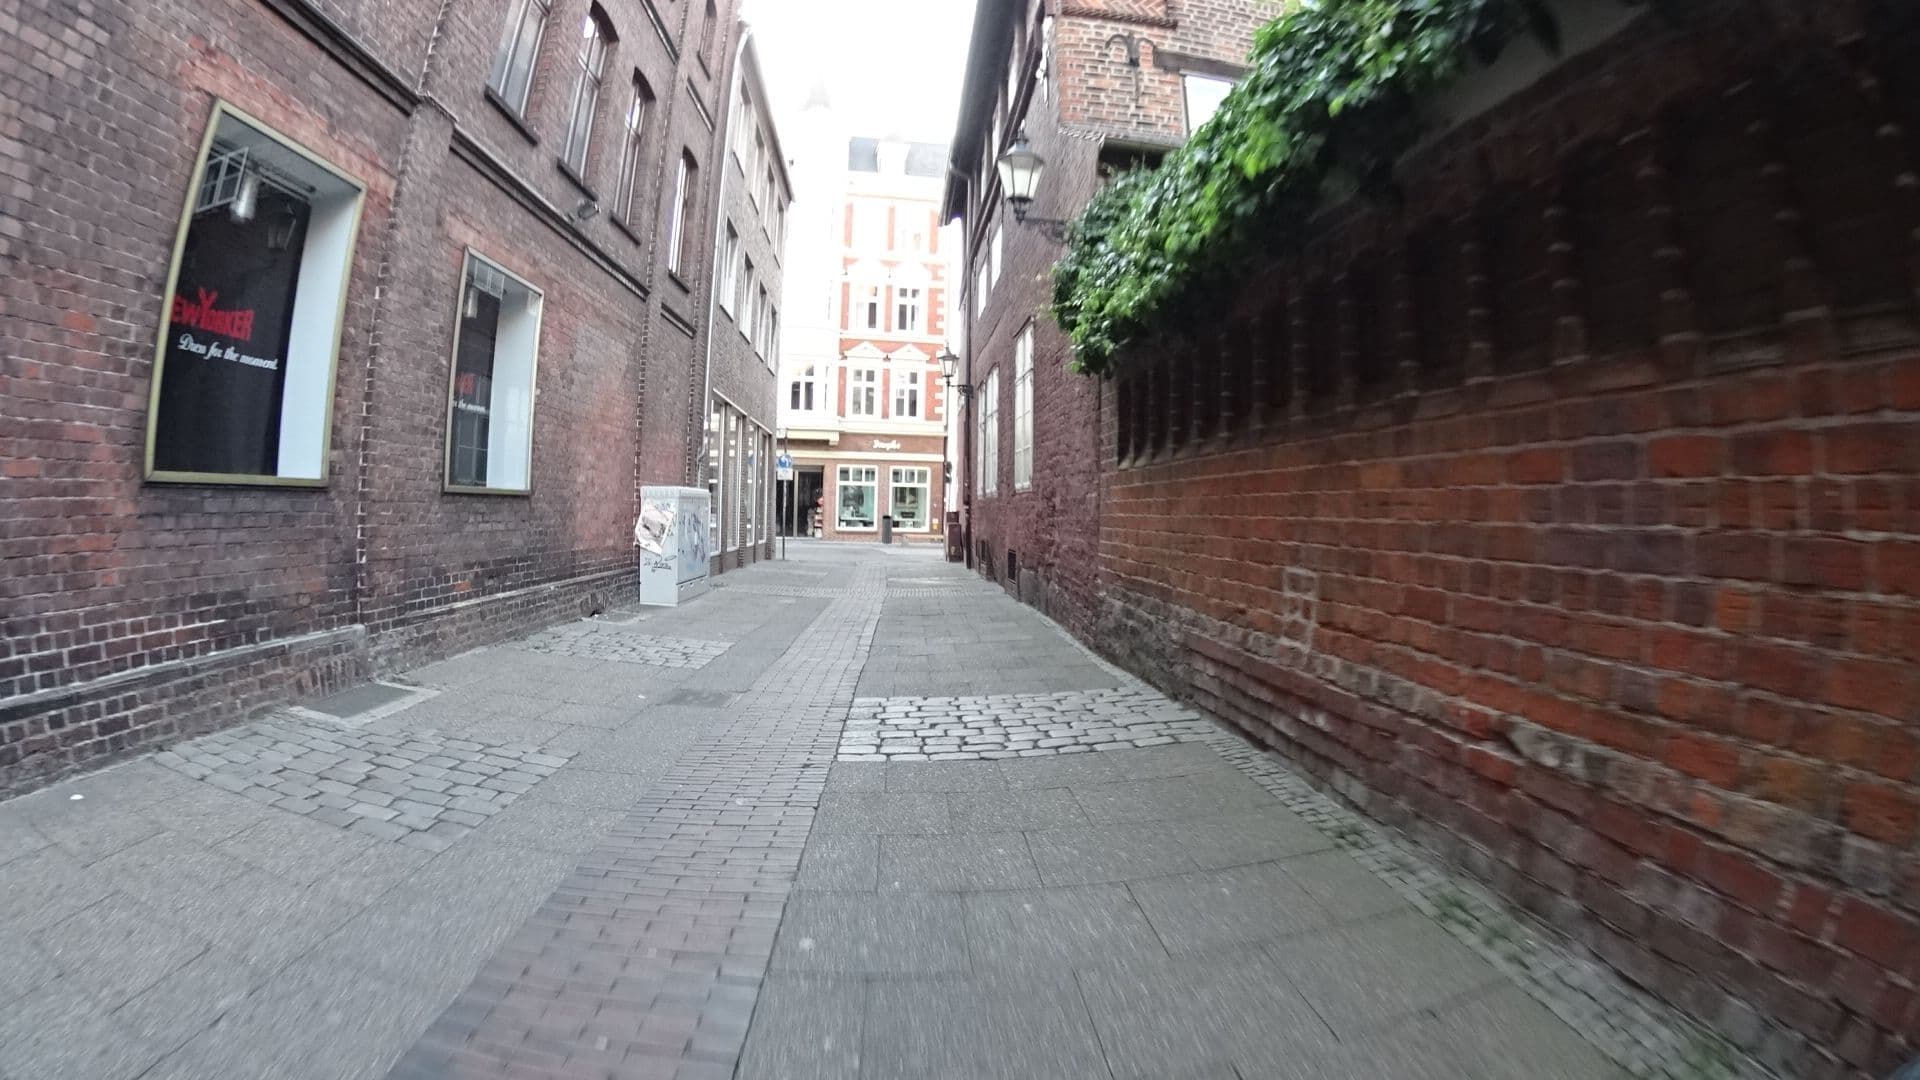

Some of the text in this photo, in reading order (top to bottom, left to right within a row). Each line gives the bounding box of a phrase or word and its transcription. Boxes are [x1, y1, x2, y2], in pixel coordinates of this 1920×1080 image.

[170, 287, 255, 341] EWYORKER
[203, 341, 223, 360] for
[223, 346, 240, 362] the
